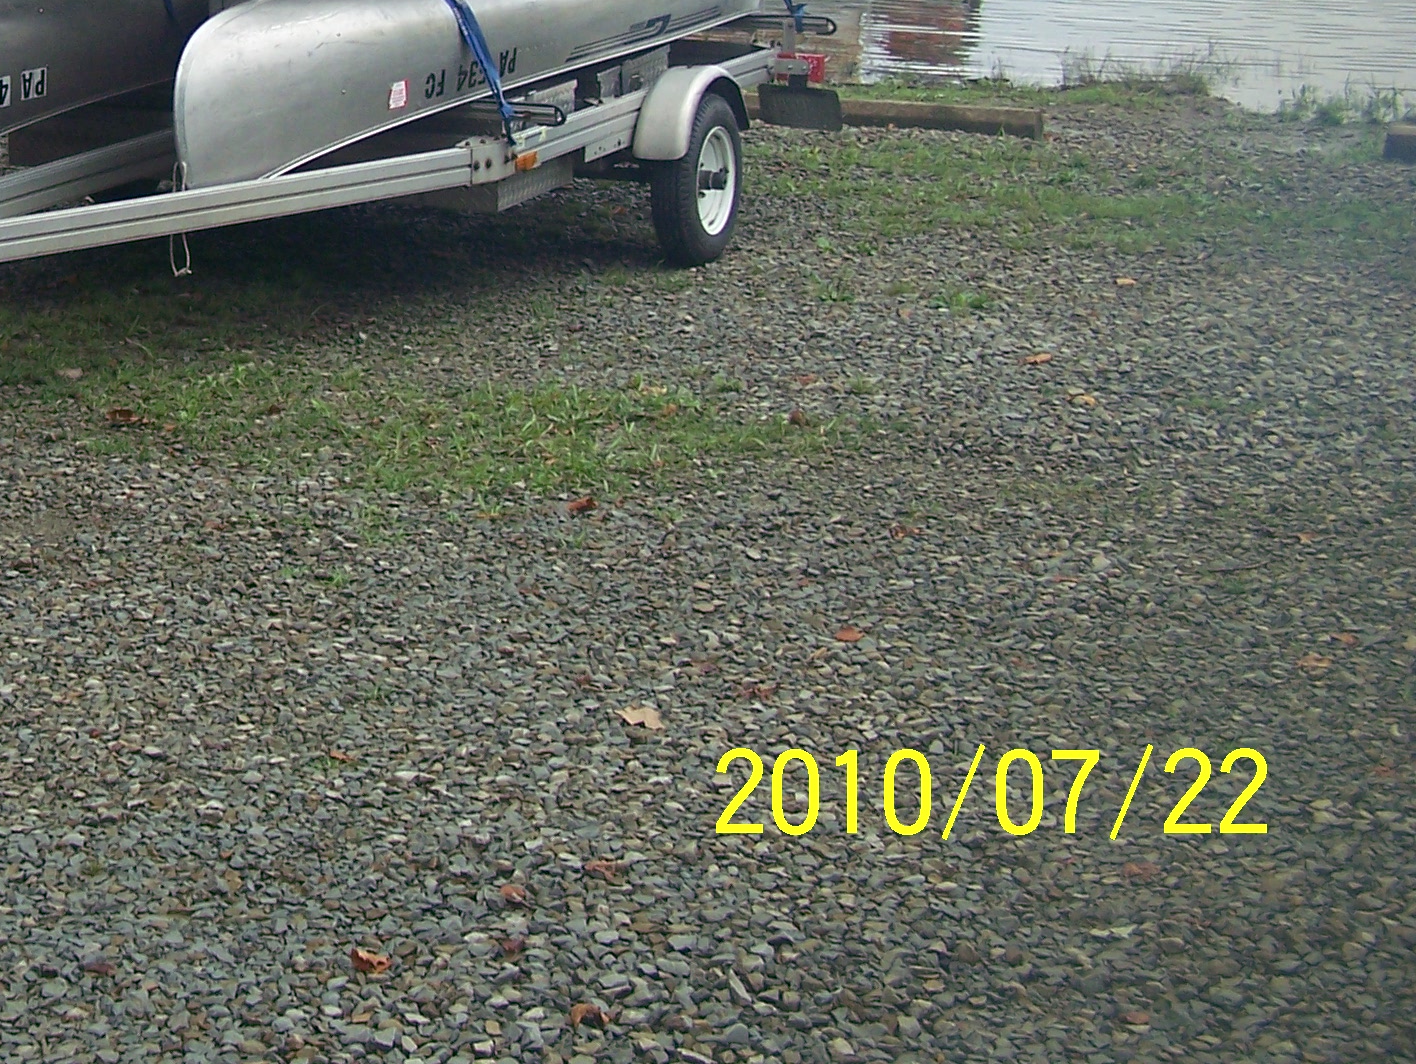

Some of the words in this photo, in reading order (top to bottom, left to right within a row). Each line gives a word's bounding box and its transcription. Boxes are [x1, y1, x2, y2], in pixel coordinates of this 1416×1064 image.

[499, 47, 517, 78] PA
[23, 69, 45, 99] PA
[425, 69, 446, 99] FC
